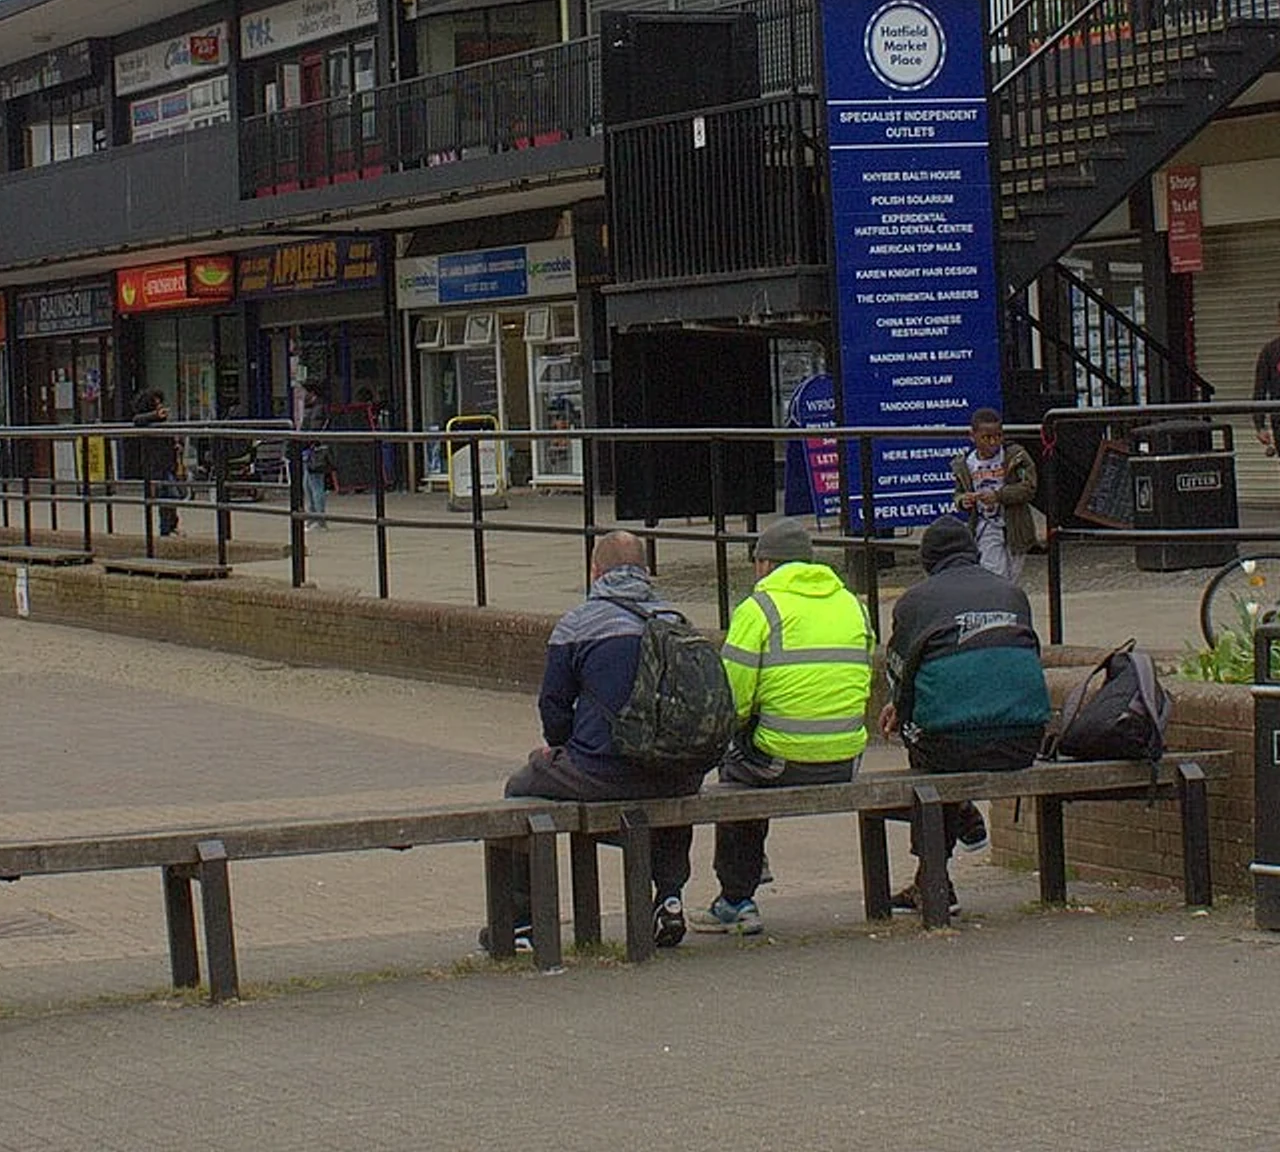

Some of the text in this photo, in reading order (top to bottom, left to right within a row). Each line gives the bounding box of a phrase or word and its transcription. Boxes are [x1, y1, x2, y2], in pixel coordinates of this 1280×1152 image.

[881, 26, 928, 38] Hatfield
[883, 41, 927, 52] Market
[890, 54, 922, 65] Place
[840, 110, 978, 123] SPECIALIST INDEPENDENT
[885, 127, 936, 137] OUTLETS
[902, 171, 929, 181] BALTI
[930, 170, 961, 180] HOUSE
[1169, 176, 1198, 191] Shop
[871, 195, 954, 205] POLISH SOLARIUM
[854, 224, 973, 236] HATFIELD DENTAL CENTRE
[870, 242, 961, 254] AMERICAN TOP NAILS
[856, 266, 977, 280] KAREN KNIGHT HAIR DESIGN
[856, 290, 979, 303] THE CONTINENTAL BARBERS
[39, 292, 91, 320] RAINBOW
[876, 314, 962, 328] CHINA SKY CHINESE
[891, 327, 949, 337] RESTAURANT
[870, 350, 973, 363] NANDINI HAIR & BEAUTY
[892, 374, 953, 387] HORIZON LAW
[880, 398, 968, 412] TANDOORI MASSALA
[882, 446, 969, 461] HERE RESTAURANT
[878, 475, 899, 486] GIFT
[900, 474, 921, 484] HAIR
[903, 503, 936, 516] LEVEL
[937, 502, 958, 514] VIA
